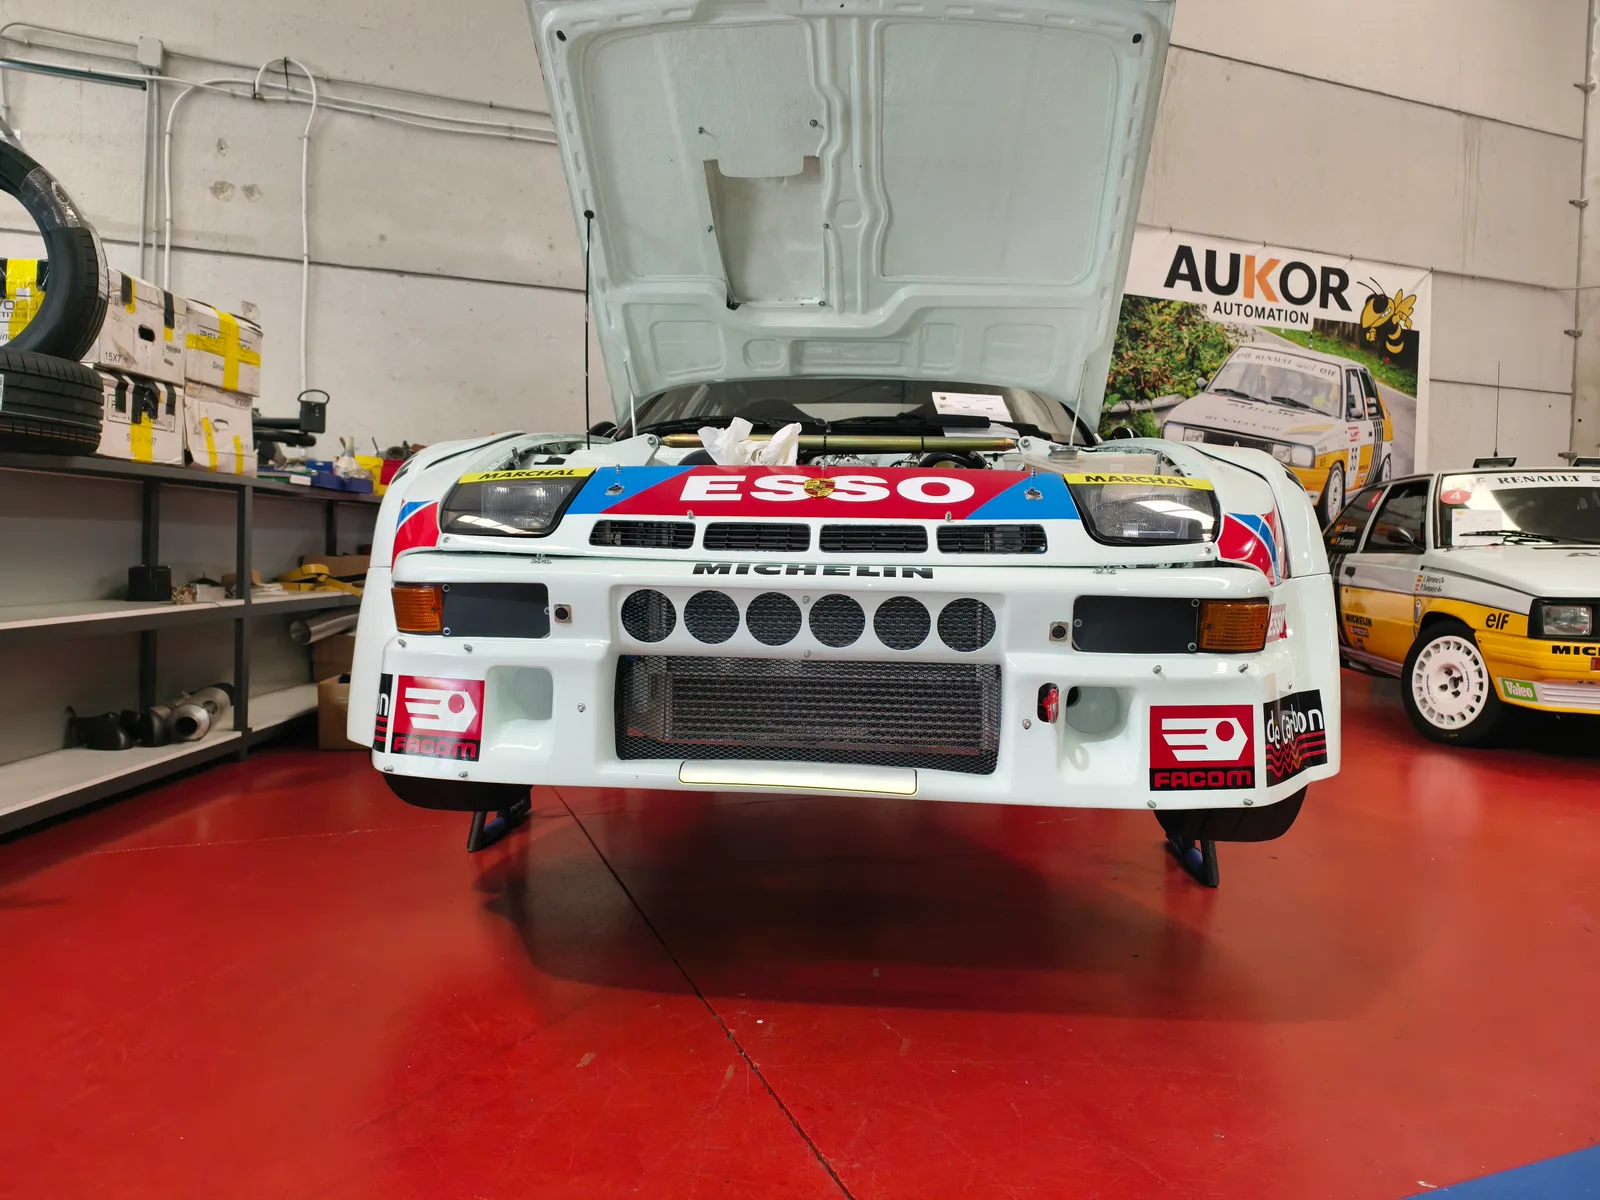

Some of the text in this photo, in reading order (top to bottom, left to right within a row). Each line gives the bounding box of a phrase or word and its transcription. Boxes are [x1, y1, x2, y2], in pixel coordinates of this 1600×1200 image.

[1164, 244, 1353, 312] AUKOR
[1213, 301, 1309, 325] AUTOMATION
[1255, 353, 1292, 366] RENAULT
[480, 469, 576, 481] MARCHAL
[1085, 473, 1195, 487] MARCHAL
[1497, 474, 1581, 485] RENAULT
[679, 475, 975, 503] ESSO
[1450, 491, 1462, 500] 4
[692, 563, 934, 579] MICHELIN
[1485, 612, 1510, 630] elf
[1551, 645, 1600, 656] MIC
[1504, 681, 1533, 698] Valeo
[393, 736, 477, 758] FACOM
[1154, 769, 1252, 788] FACOM
